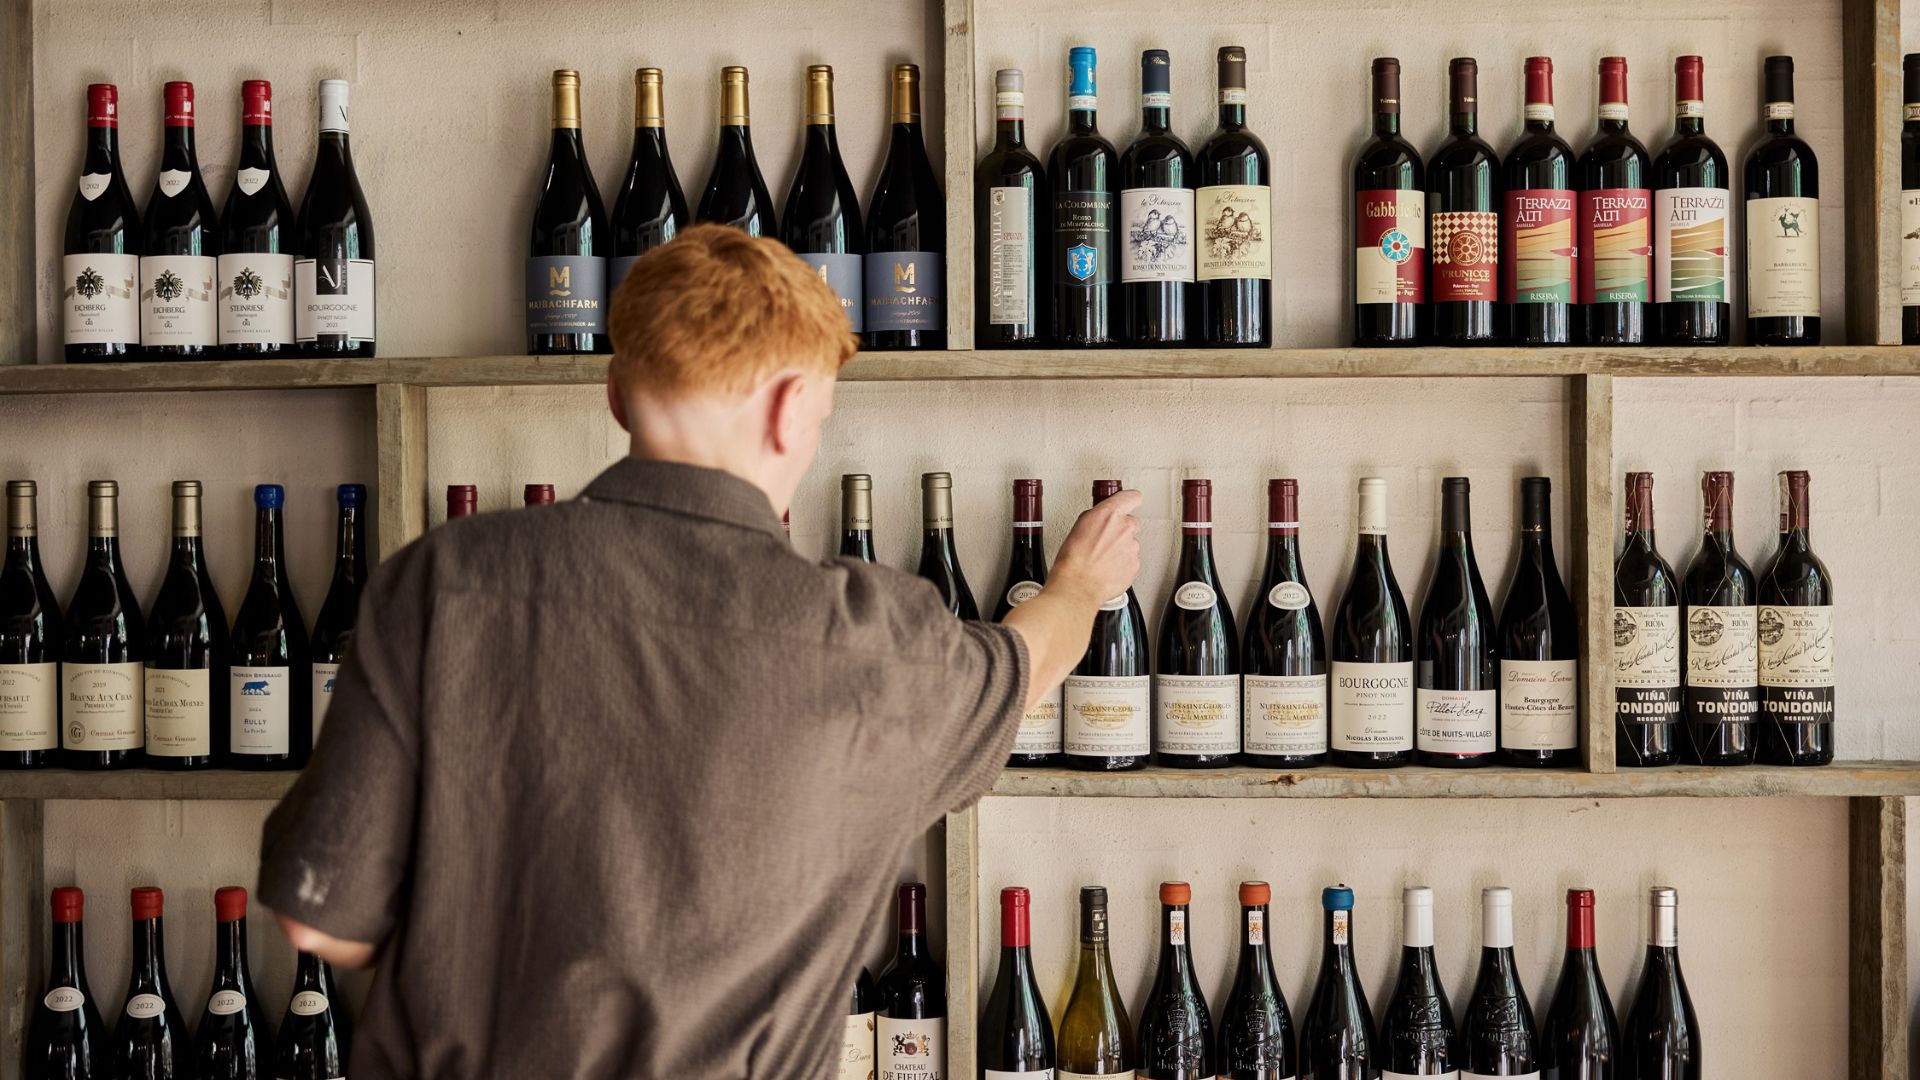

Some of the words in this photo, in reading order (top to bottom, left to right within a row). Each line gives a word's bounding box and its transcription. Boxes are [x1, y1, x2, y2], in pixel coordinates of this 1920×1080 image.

[1064, 200, 1110, 210] COLOMBINA
[1516, 197, 1571, 210] TERRAZZI
[1592, 197, 1646, 210] TERRAZZI
[1670, 196, 1724, 209] TERRAZZI
[1516, 211, 1542, 222] ALTI
[1593, 210, 1620, 222] ALTI
[1670, 210, 1696, 221] ALTI
[1442, 270, 1490, 278] PRUNICCE
[528, 300, 598, 308] MAIBACHFARM
[1508, 670, 1546, 682] Domaine
[1339, 677, 1408, 688] BOURGOGNE
[70, 692, 96, 702] BEAUNE
[98, 692, 114, 701] AUX
[116, 692, 133, 700] CRAS
[1524, 696, 1560, 704] Bourgogne
[1636, 690, 1666, 700] VIÑA
[1723, 689, 1750, 700] VIÑA
[1784, 689, 1814, 700] VIÑA
[1616, 701, 1680, 714] TONDONIA
[1763, 701, 1832, 713] TONDONIA
[1442, 730, 1492, 738] NUITS-VILLAGES
[882, 1070, 894, 1080] DE
